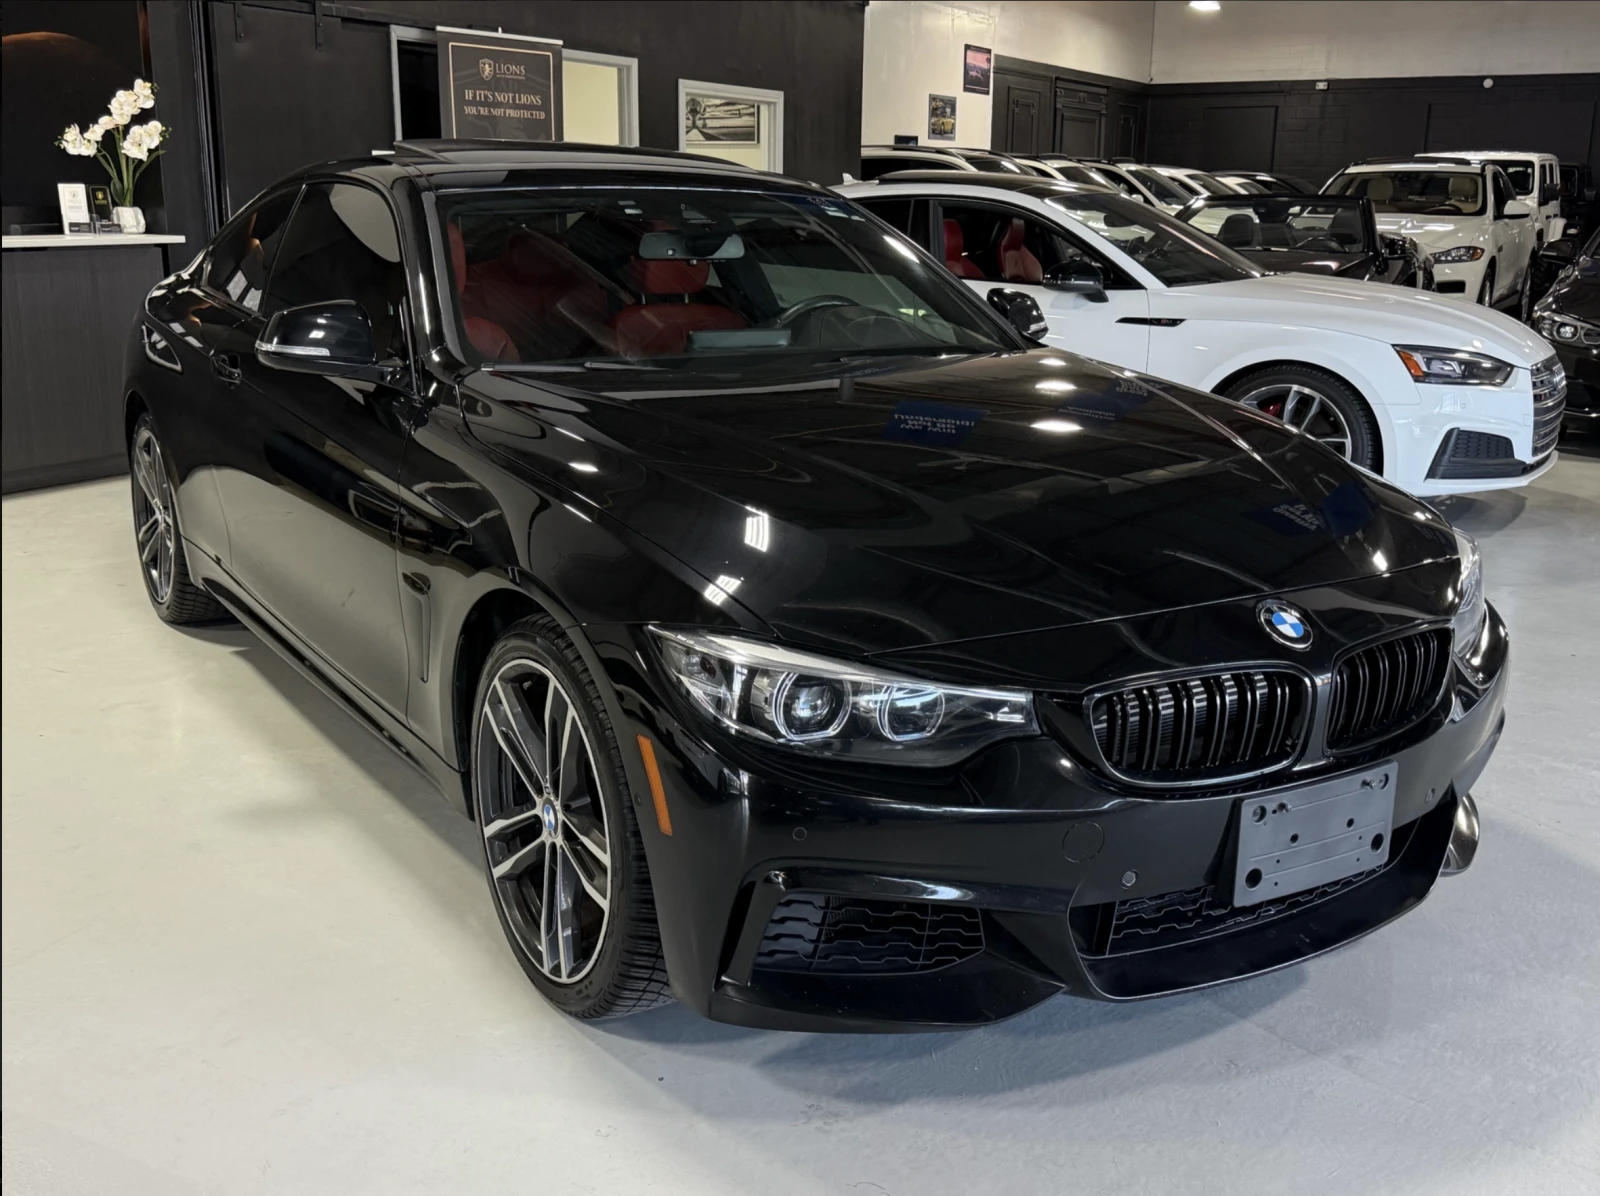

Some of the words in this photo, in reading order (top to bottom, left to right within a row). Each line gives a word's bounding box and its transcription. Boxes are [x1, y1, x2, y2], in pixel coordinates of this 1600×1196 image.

[495, 63, 525, 75] LIONS
[464, 89, 474, 100] IF
[476, 90, 493, 102] IT'S
[494, 91, 514, 104] NOT
[515, 93, 542, 106] LIONS
[463, 105, 489, 115] YOU'RE
[490, 107, 505, 117] NOT
[505, 108, 546, 120] PROTECTED
